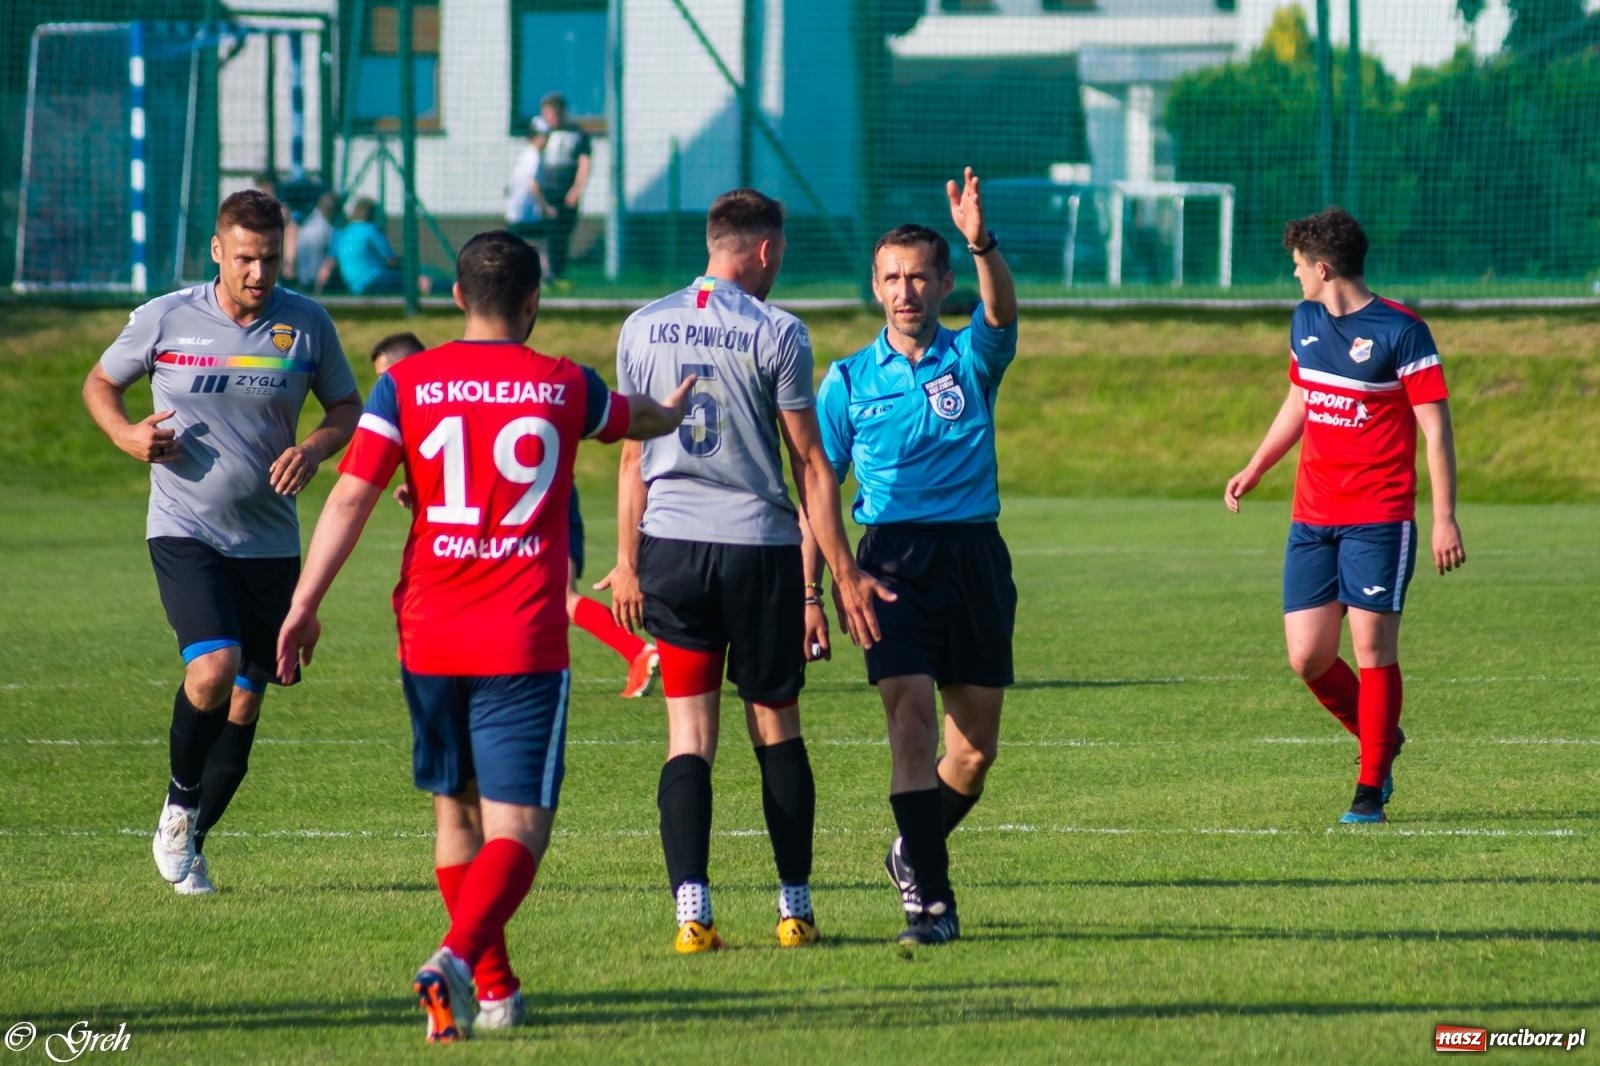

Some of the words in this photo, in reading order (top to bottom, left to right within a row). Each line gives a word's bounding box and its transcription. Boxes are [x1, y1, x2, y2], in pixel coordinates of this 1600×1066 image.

[650, 323, 680, 344] LKS
[244, 387, 273, 396] STEEL
[415, 382, 444, 406] KS
[447, 380, 566, 406] KOLEJARZ
[679, 364, 721, 458] 5
[418, 416, 560, 526] 19
